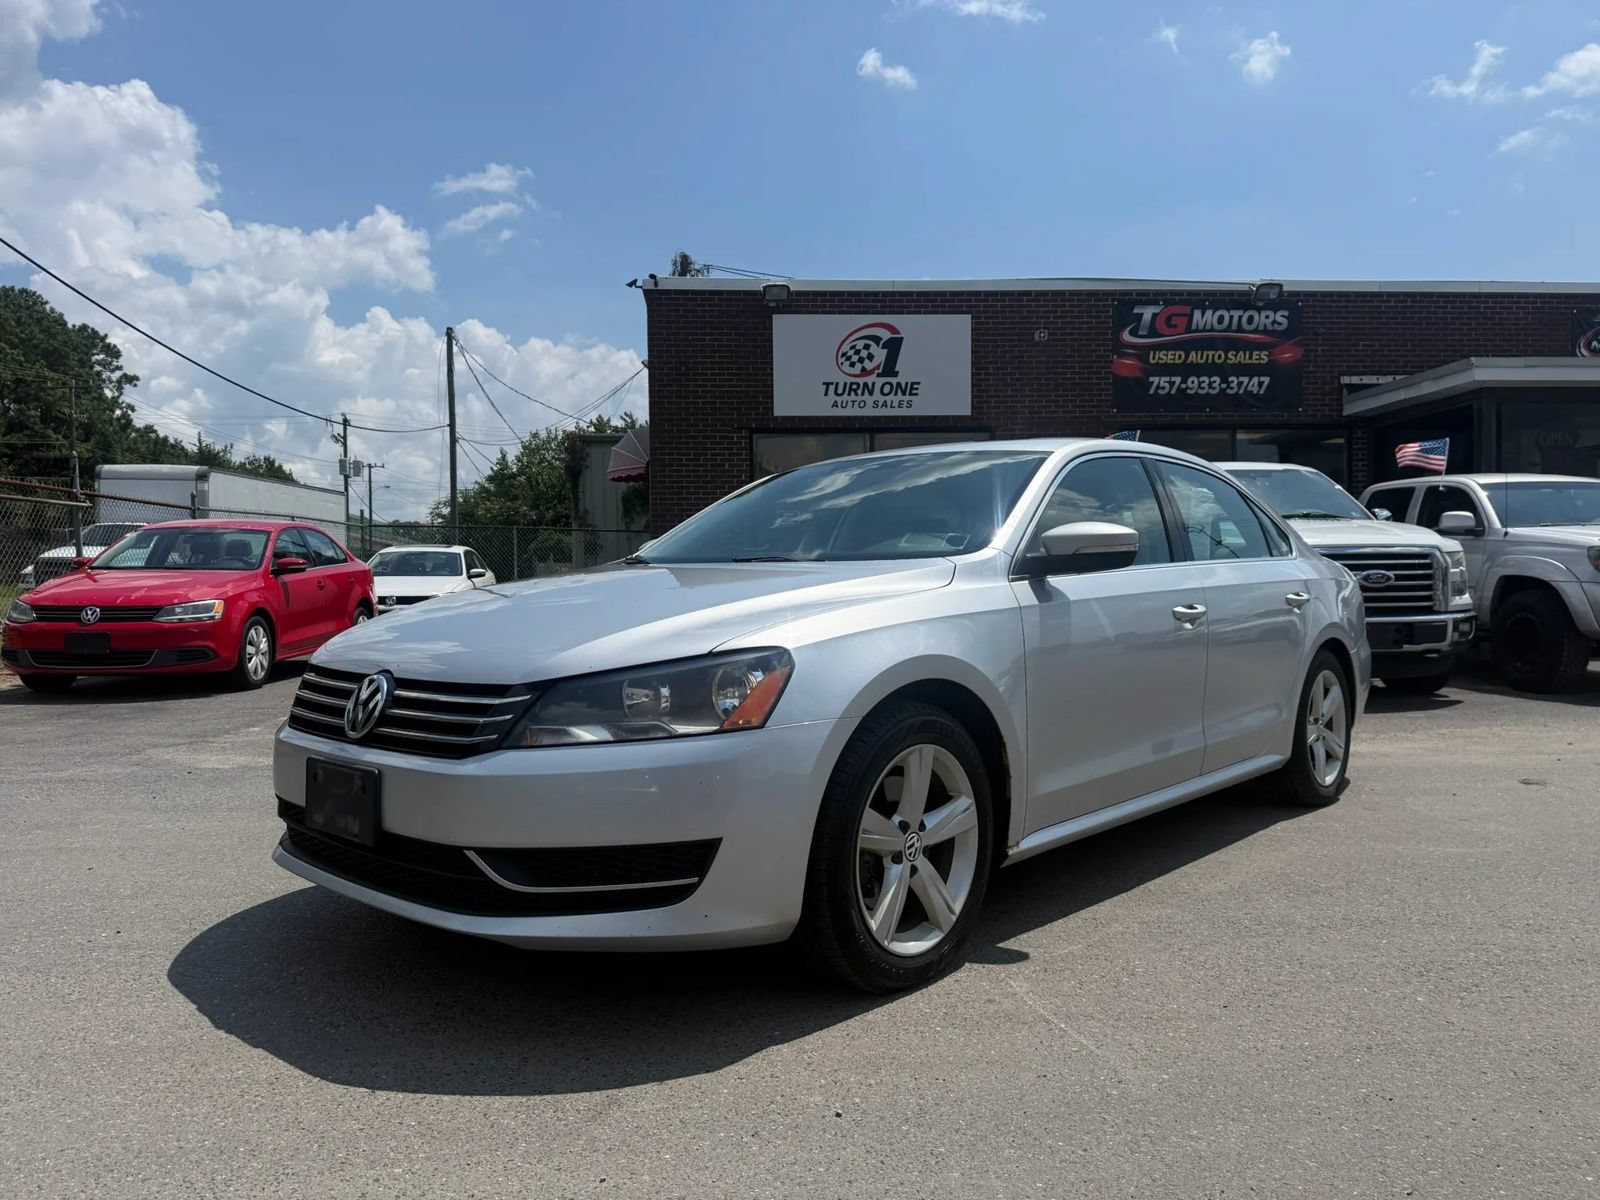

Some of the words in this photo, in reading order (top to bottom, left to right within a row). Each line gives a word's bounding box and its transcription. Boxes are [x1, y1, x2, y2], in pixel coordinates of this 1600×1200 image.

[1133, 305, 1192, 335] TG
[1191, 309, 1289, 331] MOTORS
[1149, 350, 1185, 364] USED
[1186, 350, 1224, 364] AUTO
[1226, 350, 1269, 364] SALES
[822, 382, 876, 397] TURN
[879, 382, 921, 397] ONE
[1148, 376, 1271, 395] 757-933-3747
[831, 400, 866, 409] AUTO
[872, 400, 913, 409] SALES
